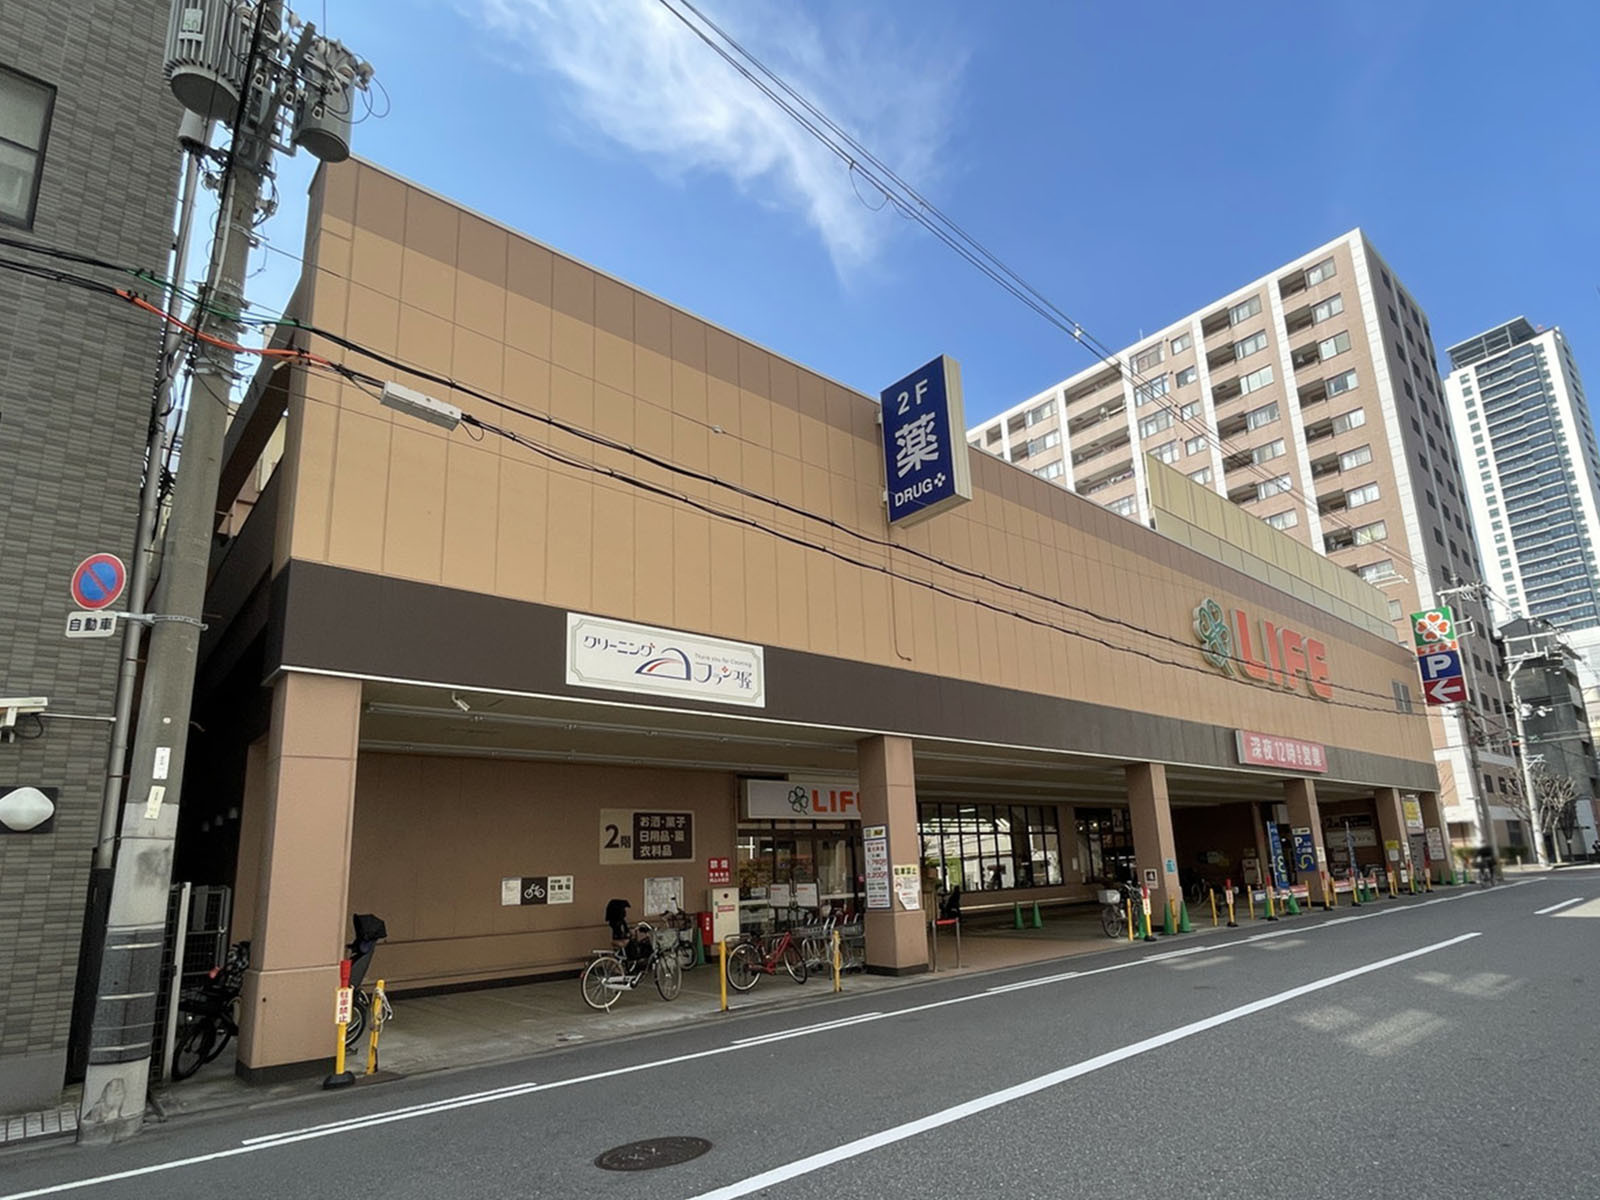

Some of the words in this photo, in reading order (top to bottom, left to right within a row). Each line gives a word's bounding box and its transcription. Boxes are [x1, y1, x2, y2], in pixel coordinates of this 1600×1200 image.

[897, 378, 928, 415] 2F
[895, 411, 939, 478] 薬
[895, 478, 933, 507] DRUG
[69, 616, 113, 631] 自動車
[583, 634, 656, 658] クリーニング
[1231, 608, 1333, 700] LIFE
[1426, 654, 1452, 679] P
[812, 789, 861, 813] LIF
[604, 823, 632, 849] 2階
[640, 844, 673, 857] 衣料品
